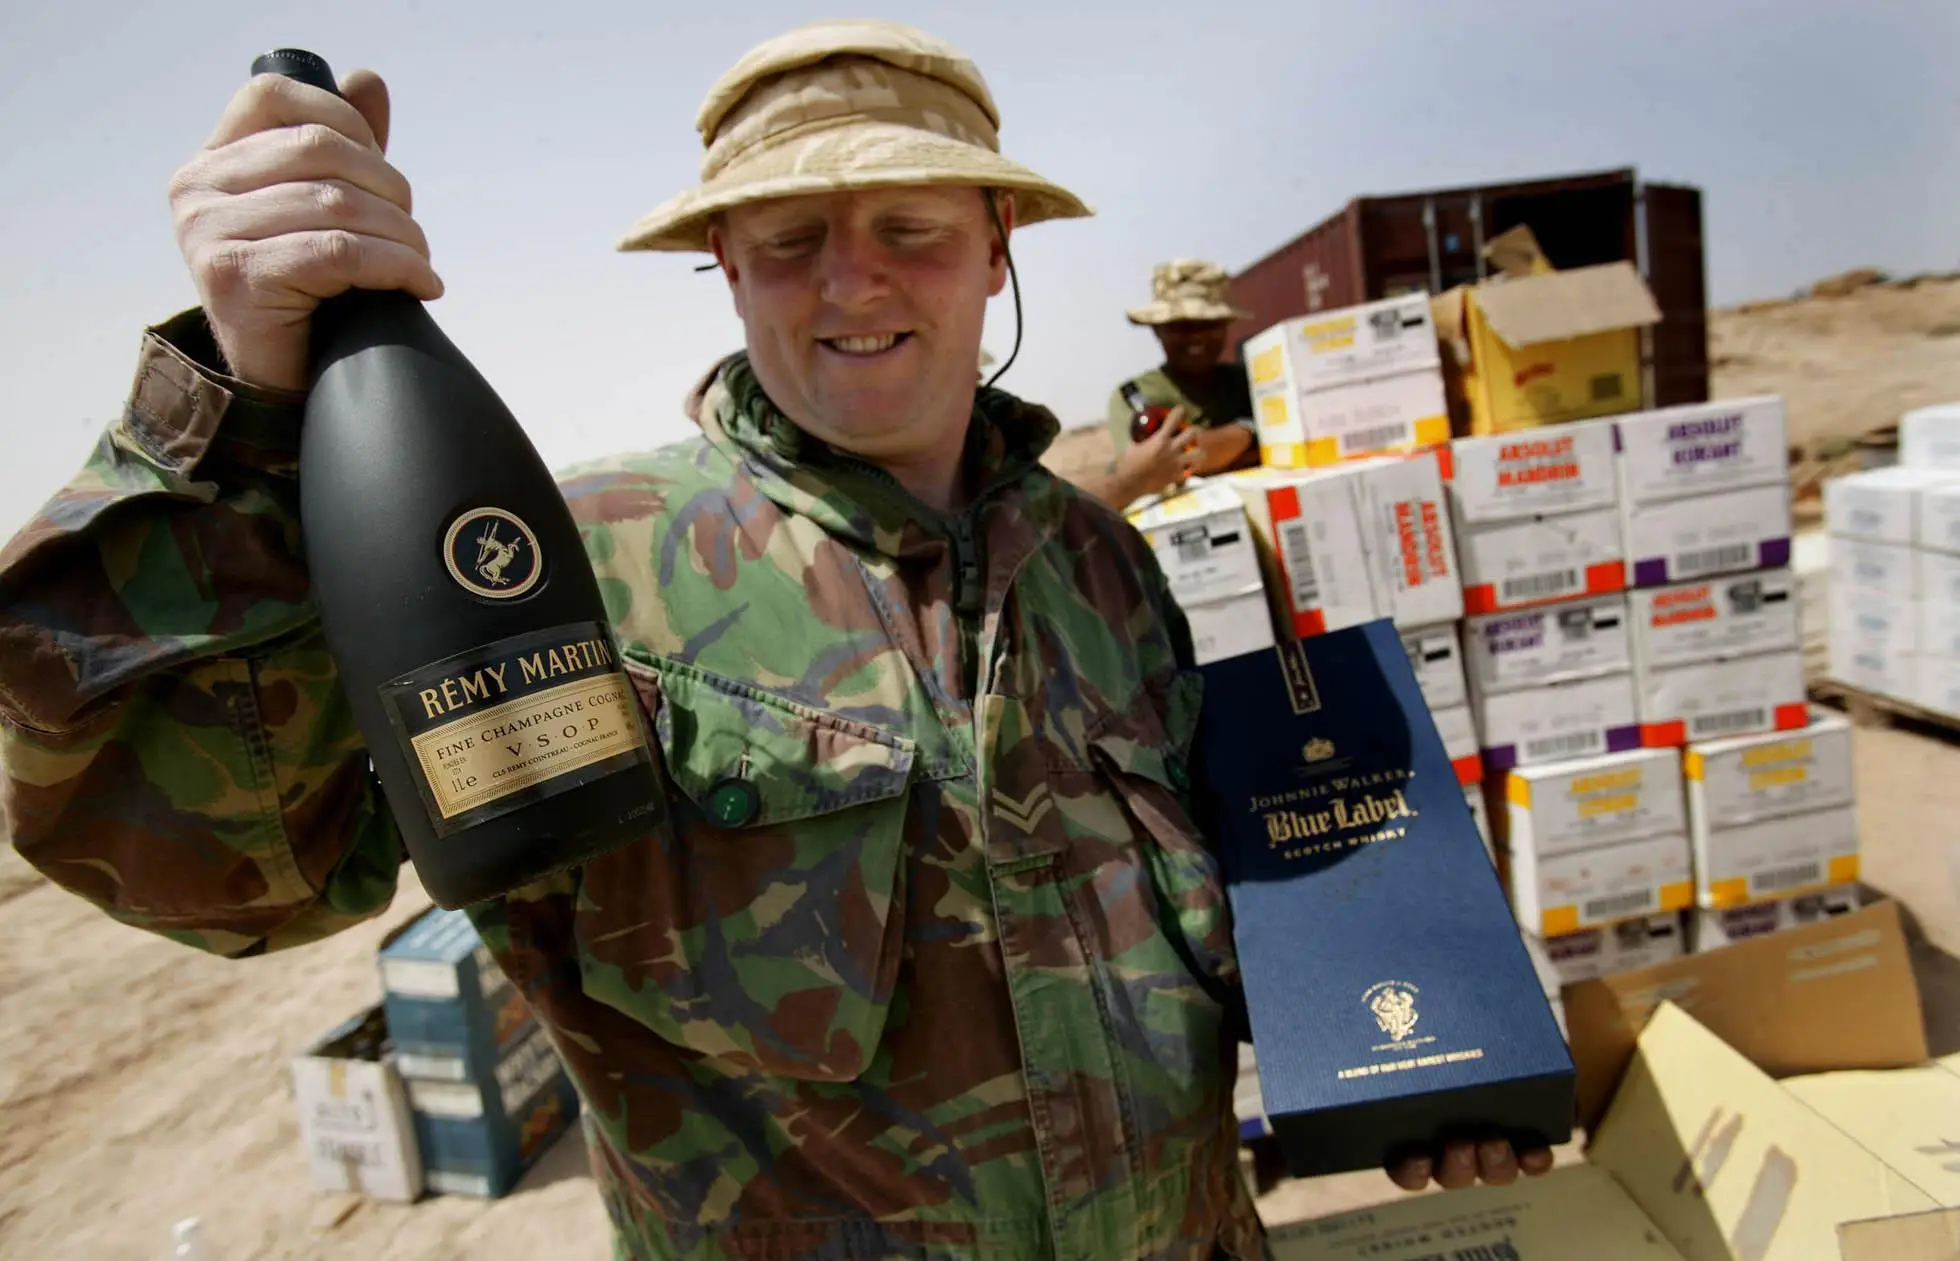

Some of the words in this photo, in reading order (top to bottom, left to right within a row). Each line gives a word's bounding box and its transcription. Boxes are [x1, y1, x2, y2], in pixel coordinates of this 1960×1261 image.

[418, 662, 509, 719] RÉMY
[517, 639, 613, 685] MARTIN
[436, 737, 475, 760] FINE
[481, 700, 584, 742] CHAMPAGNE
[1249, 784, 1329, 812] JOHNNIE
[1263, 810, 1332, 849] Blue
[1284, 841, 1342, 860] SCOTCH
[1348, 827, 1406, 846] WHISKY
